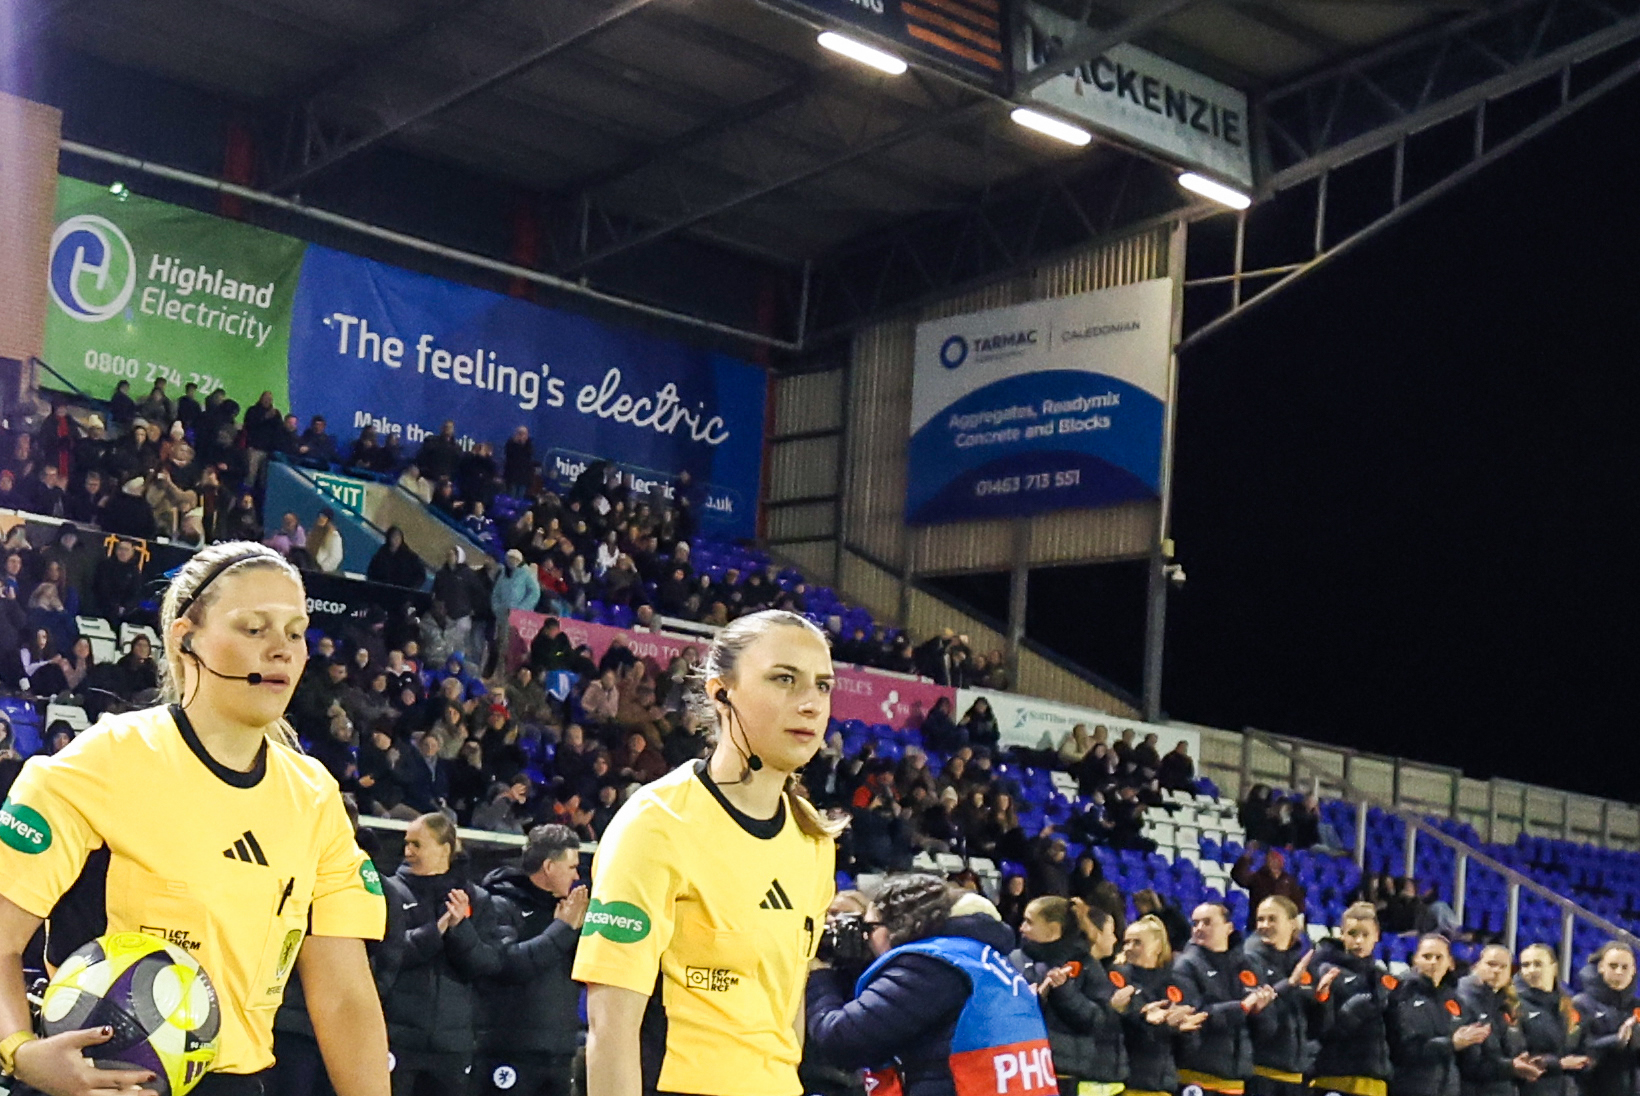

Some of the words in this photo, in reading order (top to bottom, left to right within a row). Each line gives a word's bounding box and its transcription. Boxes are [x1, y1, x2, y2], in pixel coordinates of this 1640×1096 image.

[148, 253, 275, 309] Highland
[140, 286, 272, 347] Electricity
[975, 330, 1038, 351] TARMAC
[1061, 320, 1141, 342] CALEDONIAN
[84, 350, 139, 378] 0800
[416, 334, 565, 410] feeling's
[576, 367, 730, 446] electric
[354, 410, 402, 436] Make
[949, 403, 1038, 430] Aggregates,
[1042, 390, 1121, 415] Readymix
[954, 427, 1020, 447] Concrete
[1024, 420, 1054, 438] and
[1059, 414, 1111, 434] Blocks
[975, 475, 1021, 496] 01463
[1025, 472, 1050, 489] 713
[1054, 468, 1081, 486] 551
